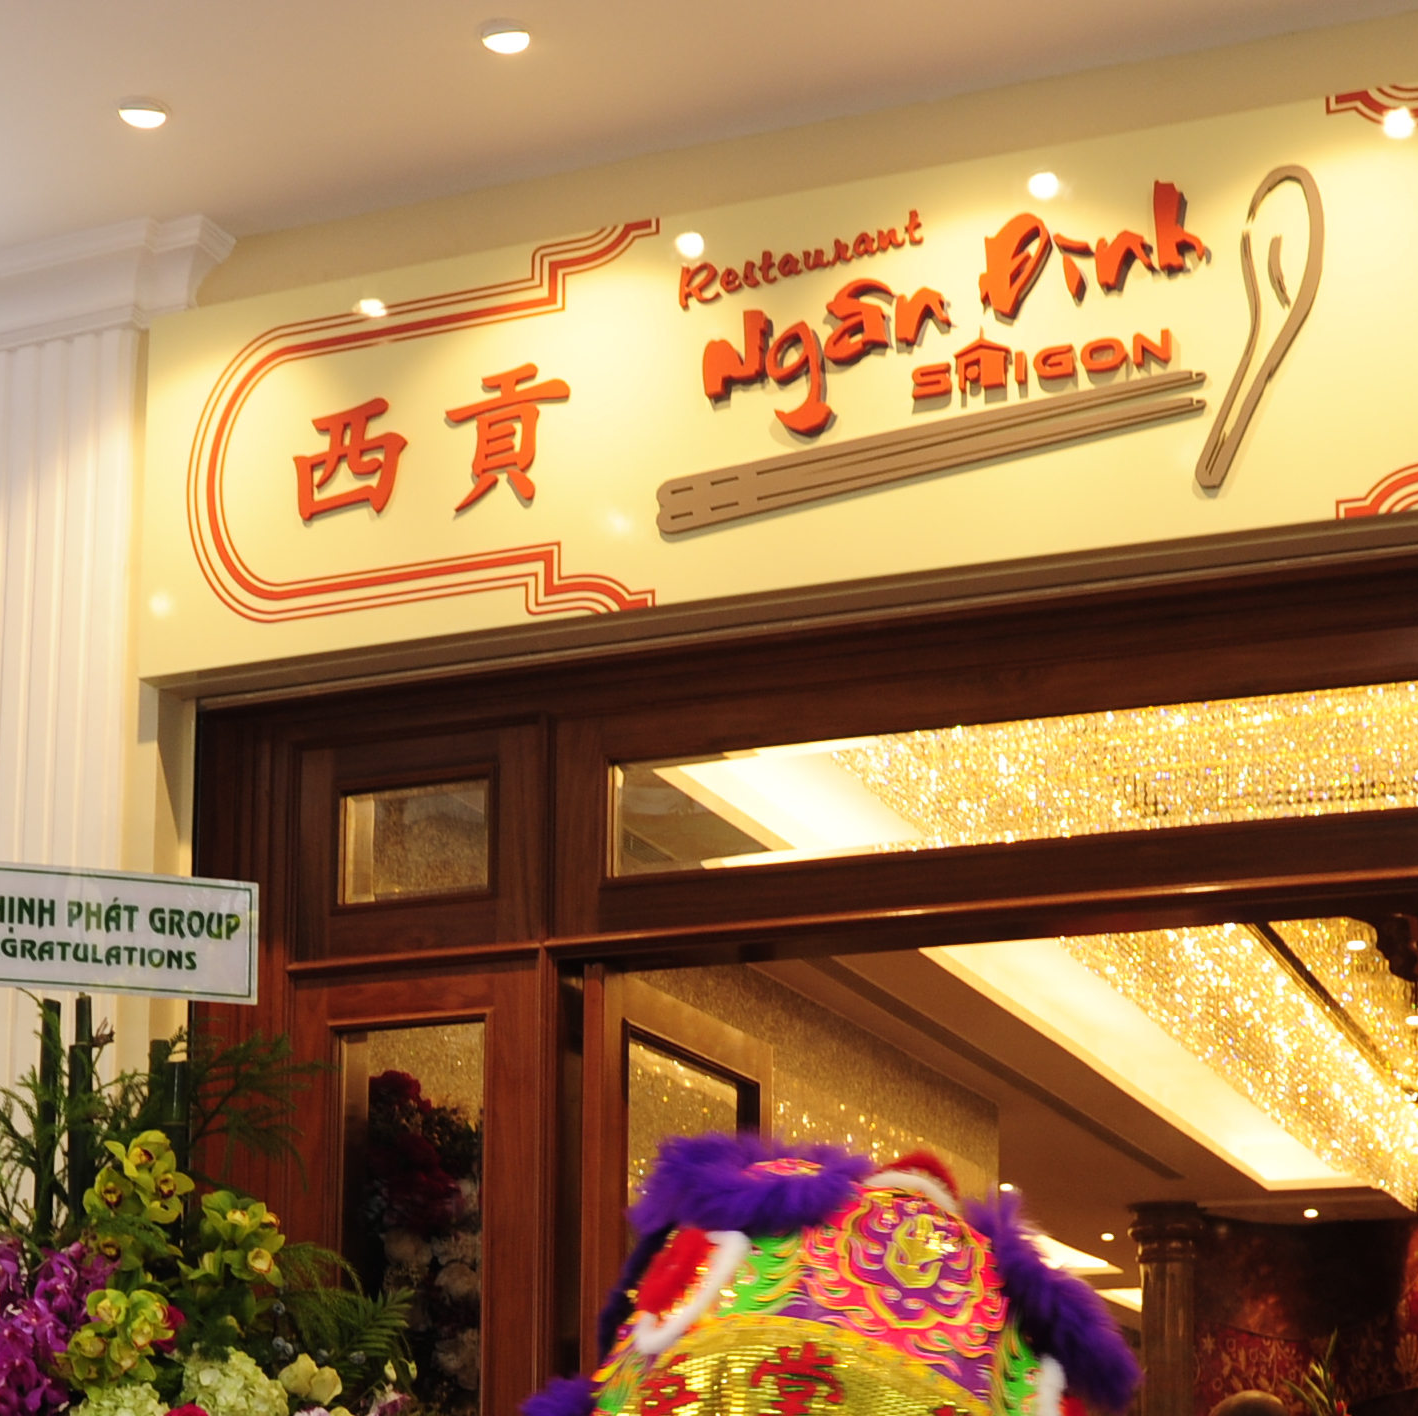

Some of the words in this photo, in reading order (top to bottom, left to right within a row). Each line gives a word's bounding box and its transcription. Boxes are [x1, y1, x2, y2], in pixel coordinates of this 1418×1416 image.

[678, 208, 925, 310] Restaurant
[702, 277, 952, 434] Ngân
[978, 179, 1207, 317] Đình
[292, 362, 572, 521] 西貢
[67, 897, 140, 934] PHÁT
[148, 907, 242, 941] GROUP
